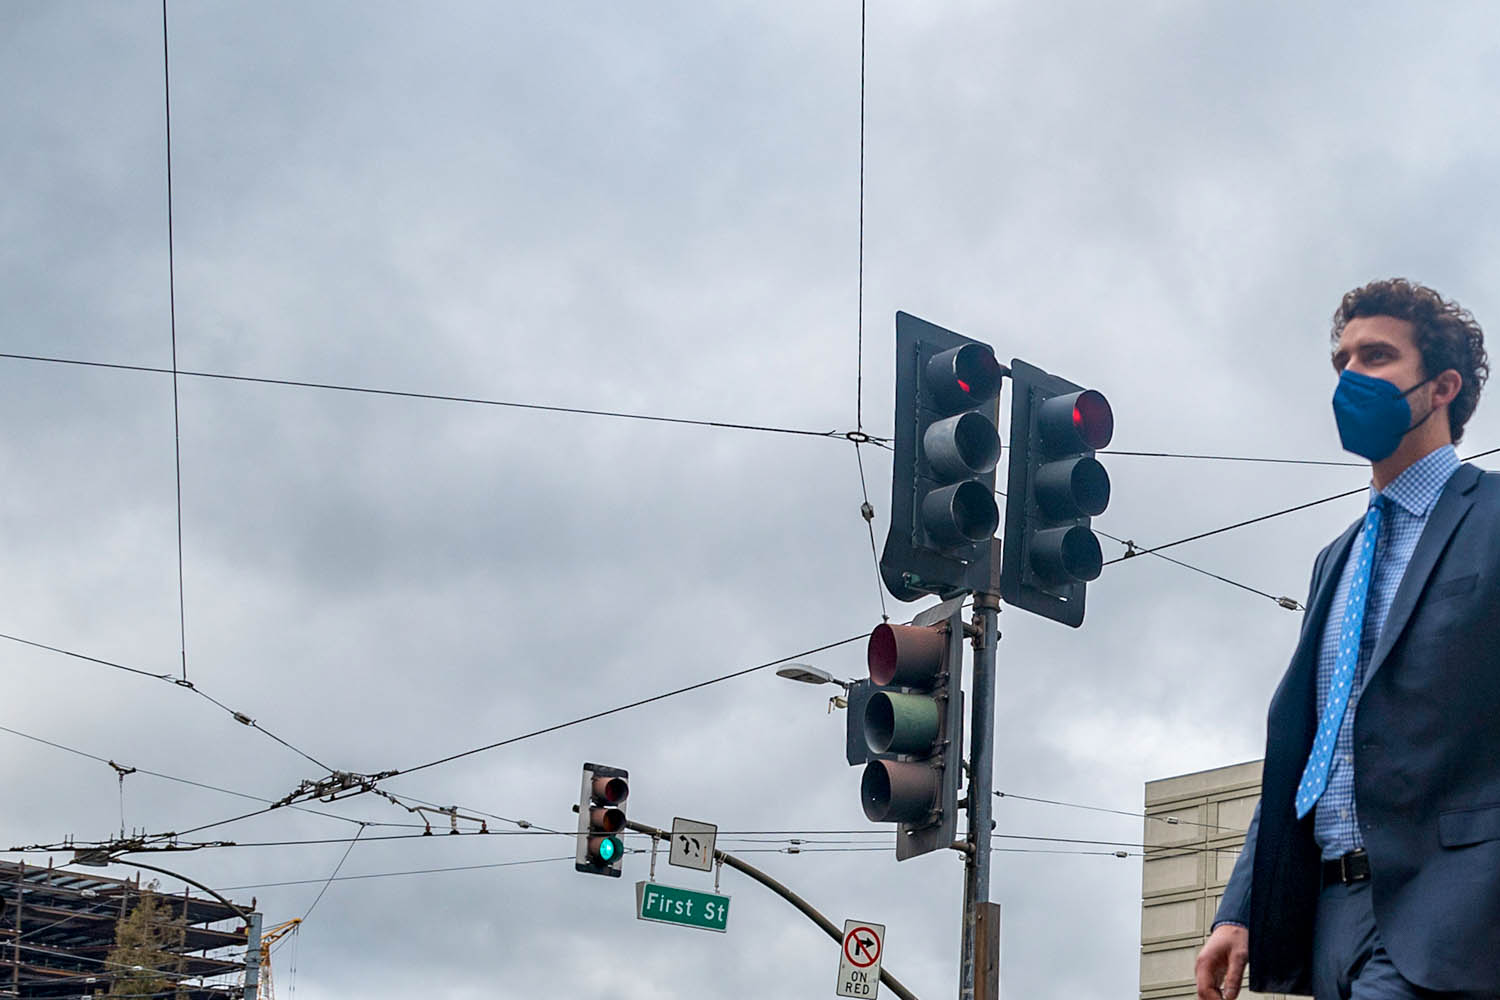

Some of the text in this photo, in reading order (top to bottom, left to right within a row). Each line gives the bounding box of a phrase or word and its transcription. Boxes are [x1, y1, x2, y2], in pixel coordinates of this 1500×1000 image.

[646, 892, 726, 922] First St
[851, 971, 868, 984] ON
[845, 982, 870, 995] RED
